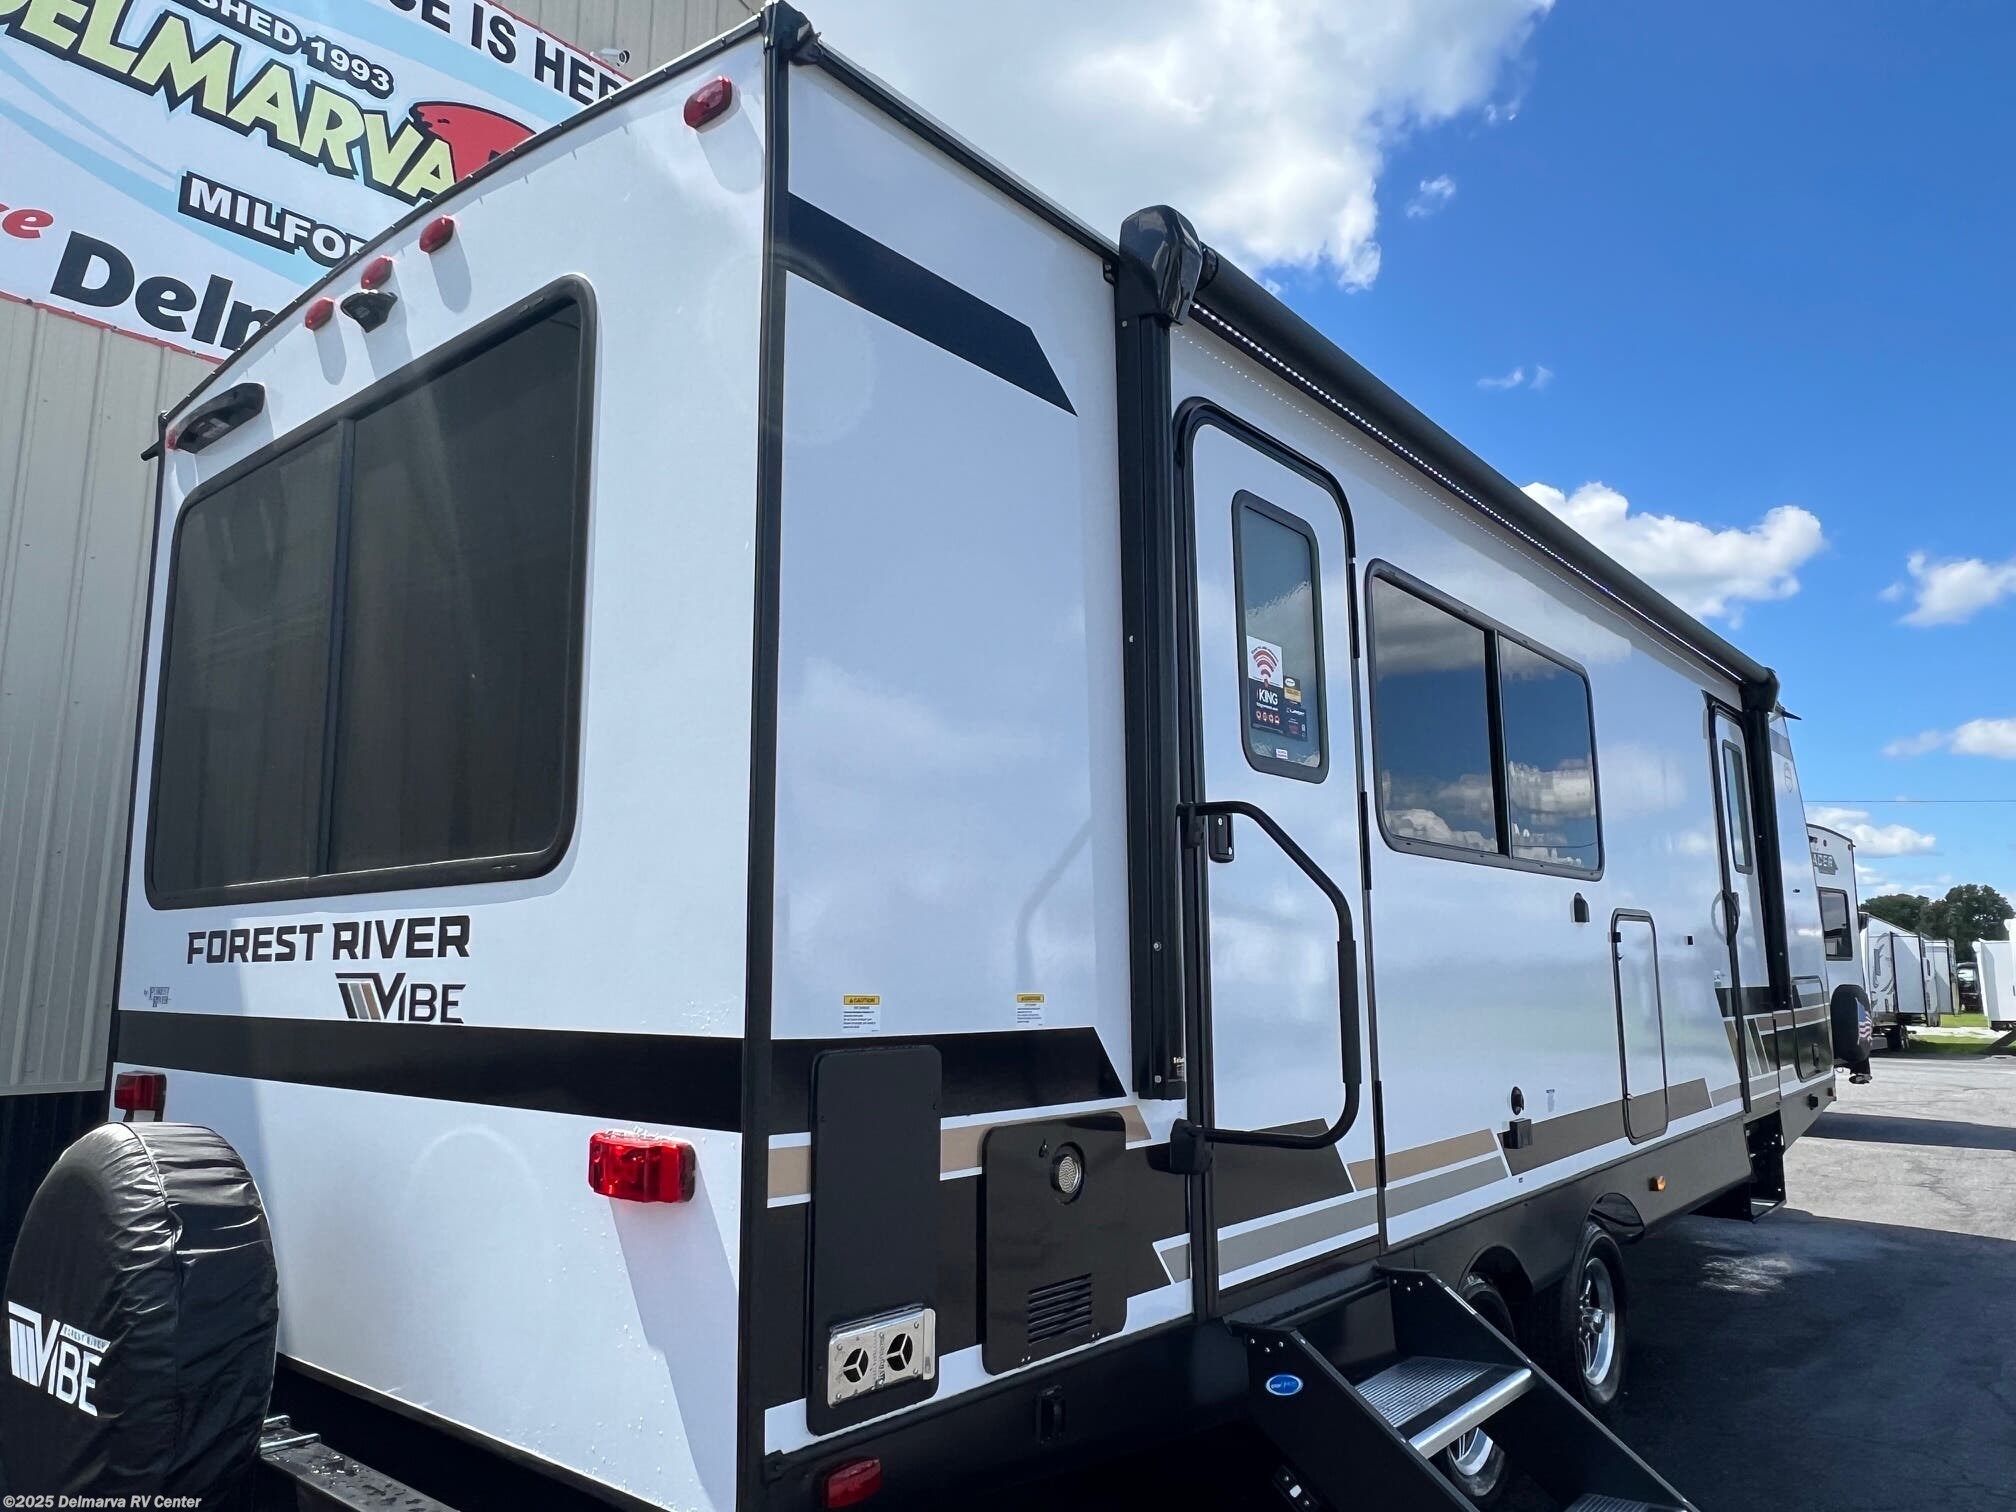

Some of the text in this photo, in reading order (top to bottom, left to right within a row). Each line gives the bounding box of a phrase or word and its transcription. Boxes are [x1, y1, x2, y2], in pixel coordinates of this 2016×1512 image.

[201, 0, 391, 92] HED 1993
[471, 2, 517, 64] IS
[0, 0, 457, 199] ELMARVA
[0, 202, 54, 239] e
[188, 177, 368, 264] MILFO
[1259, 688, 1279, 706] KING
[187, 915, 471, 964] FOREST RIVER
[335, 972, 467, 1024] VIBE
[8, 1300, 103, 1417] VIBE
